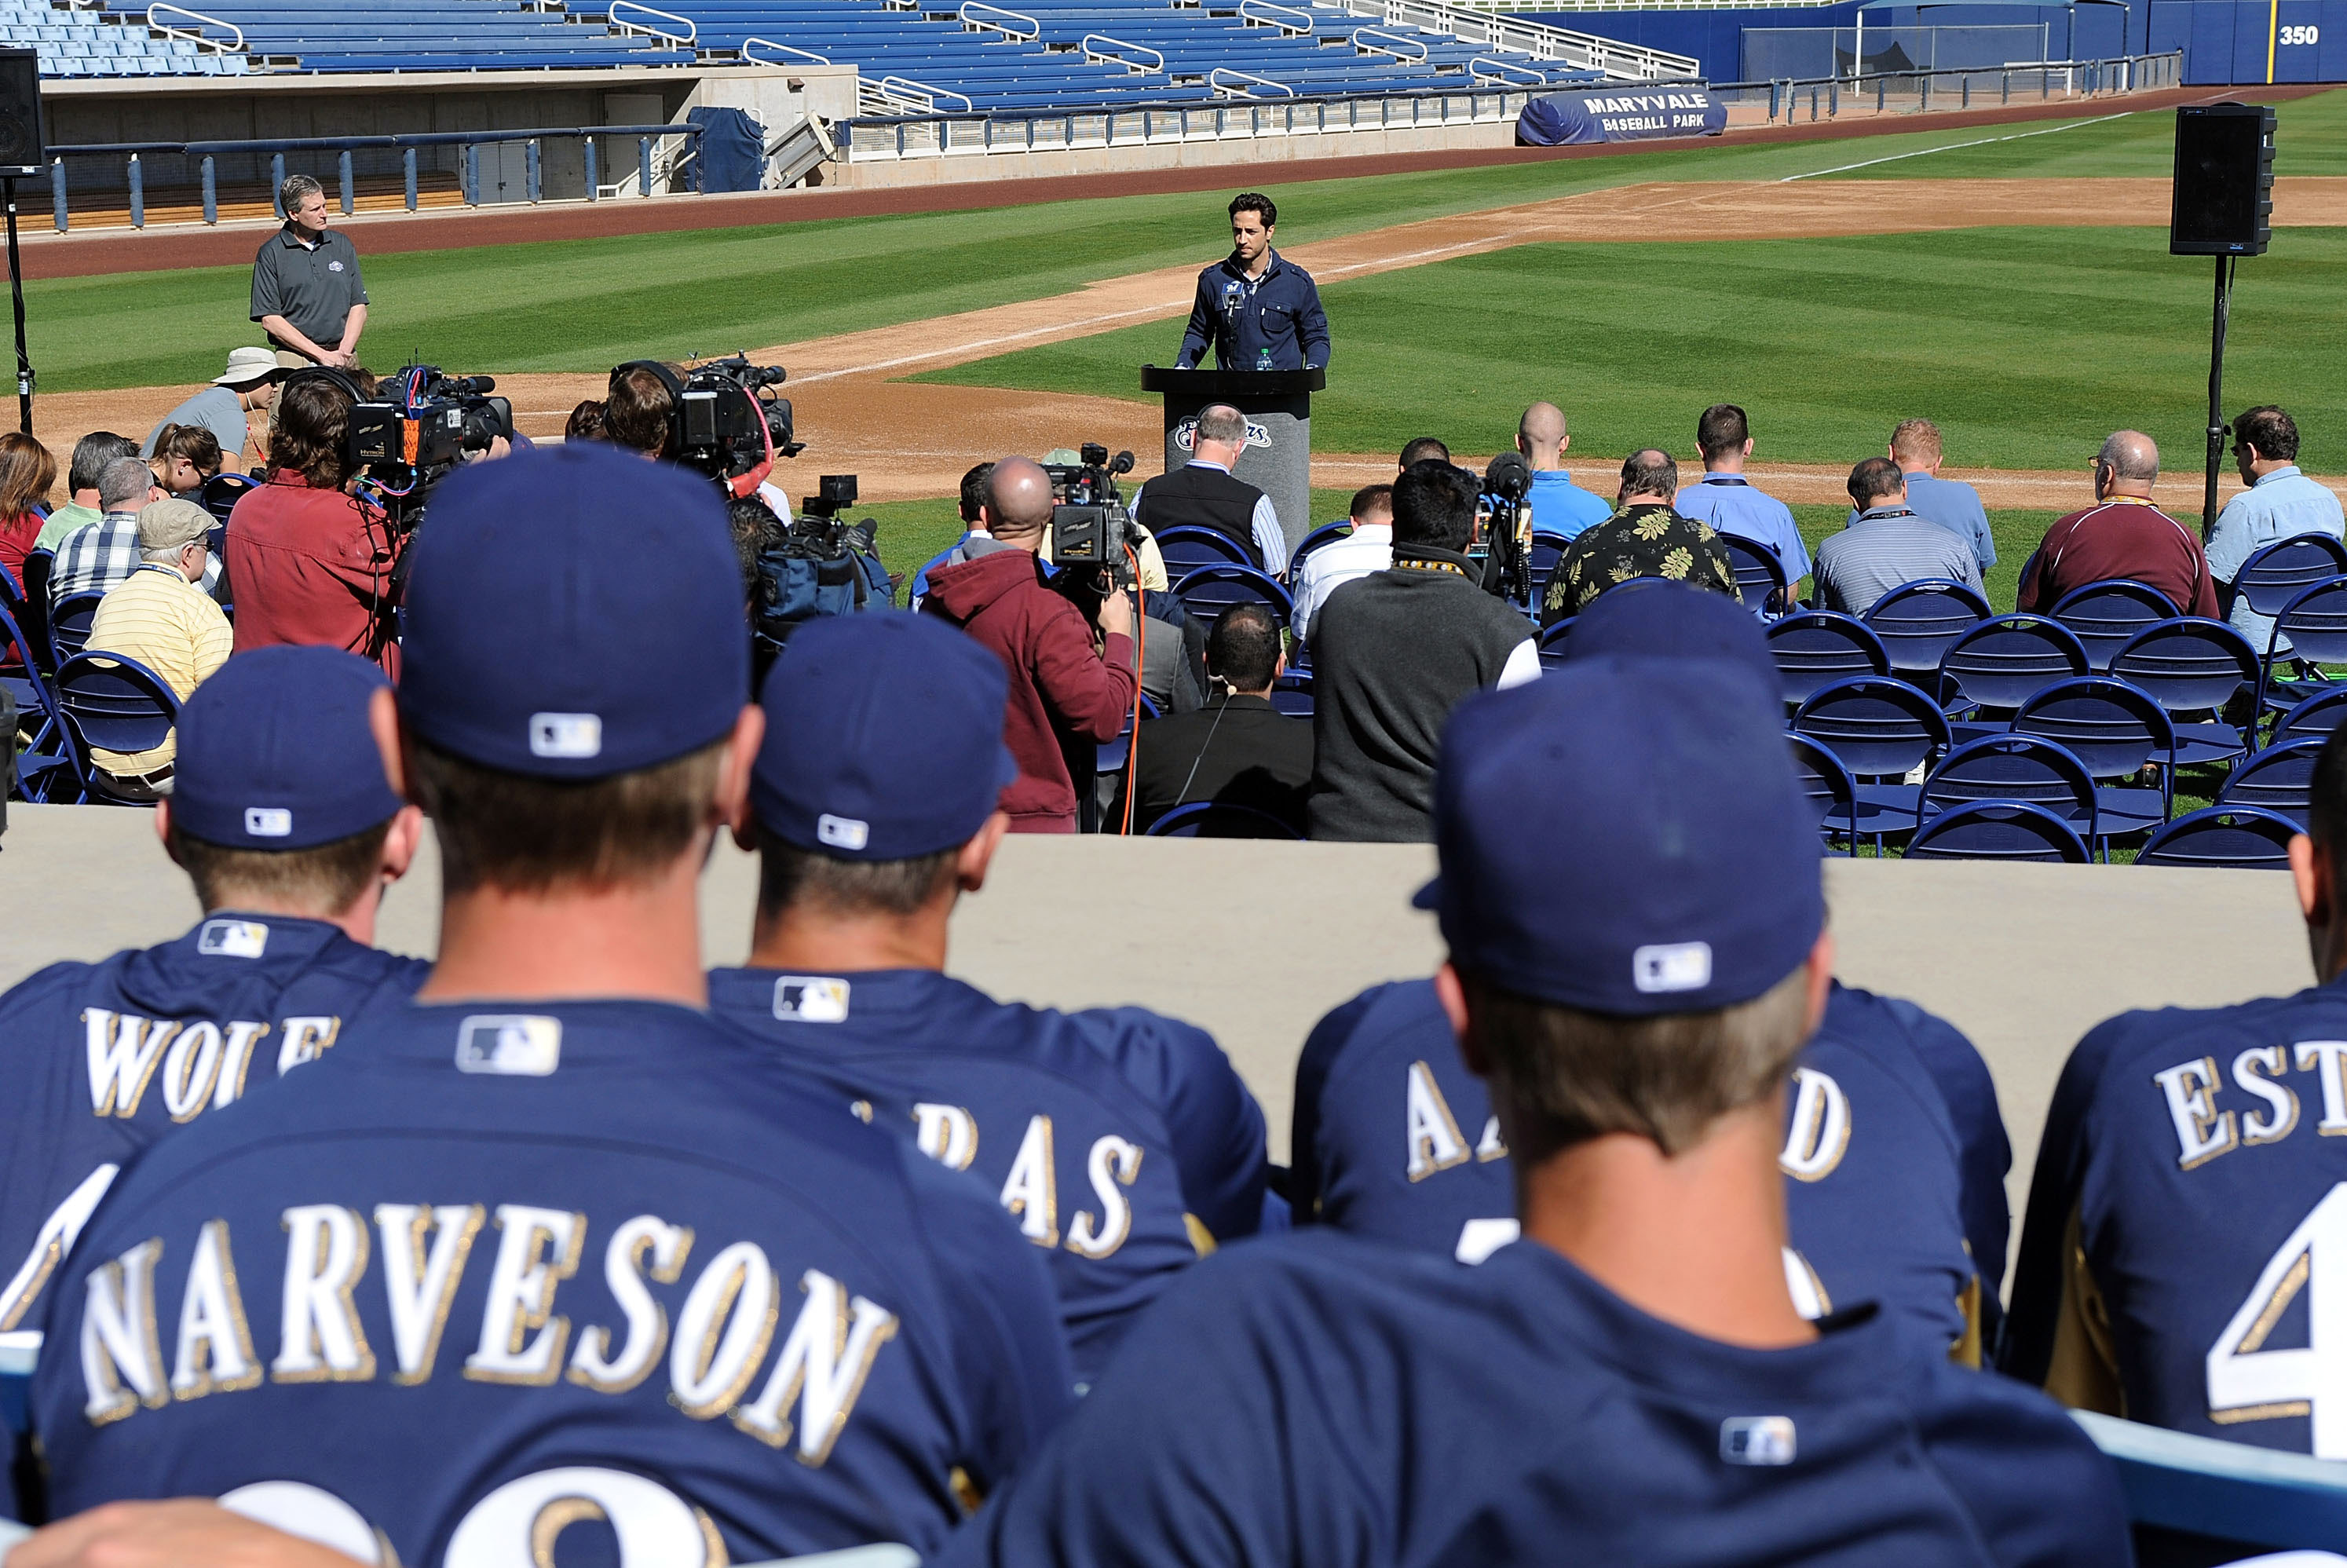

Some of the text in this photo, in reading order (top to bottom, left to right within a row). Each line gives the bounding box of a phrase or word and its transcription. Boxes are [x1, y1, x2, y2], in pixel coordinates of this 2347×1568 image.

[2279, 25, 2319, 46] 350
[1584, 93, 1709, 115] MARYVALE
[1602, 115, 1705, 131] BASEBALL PARK
[80, 1202, 900, 1468] NARVESON
